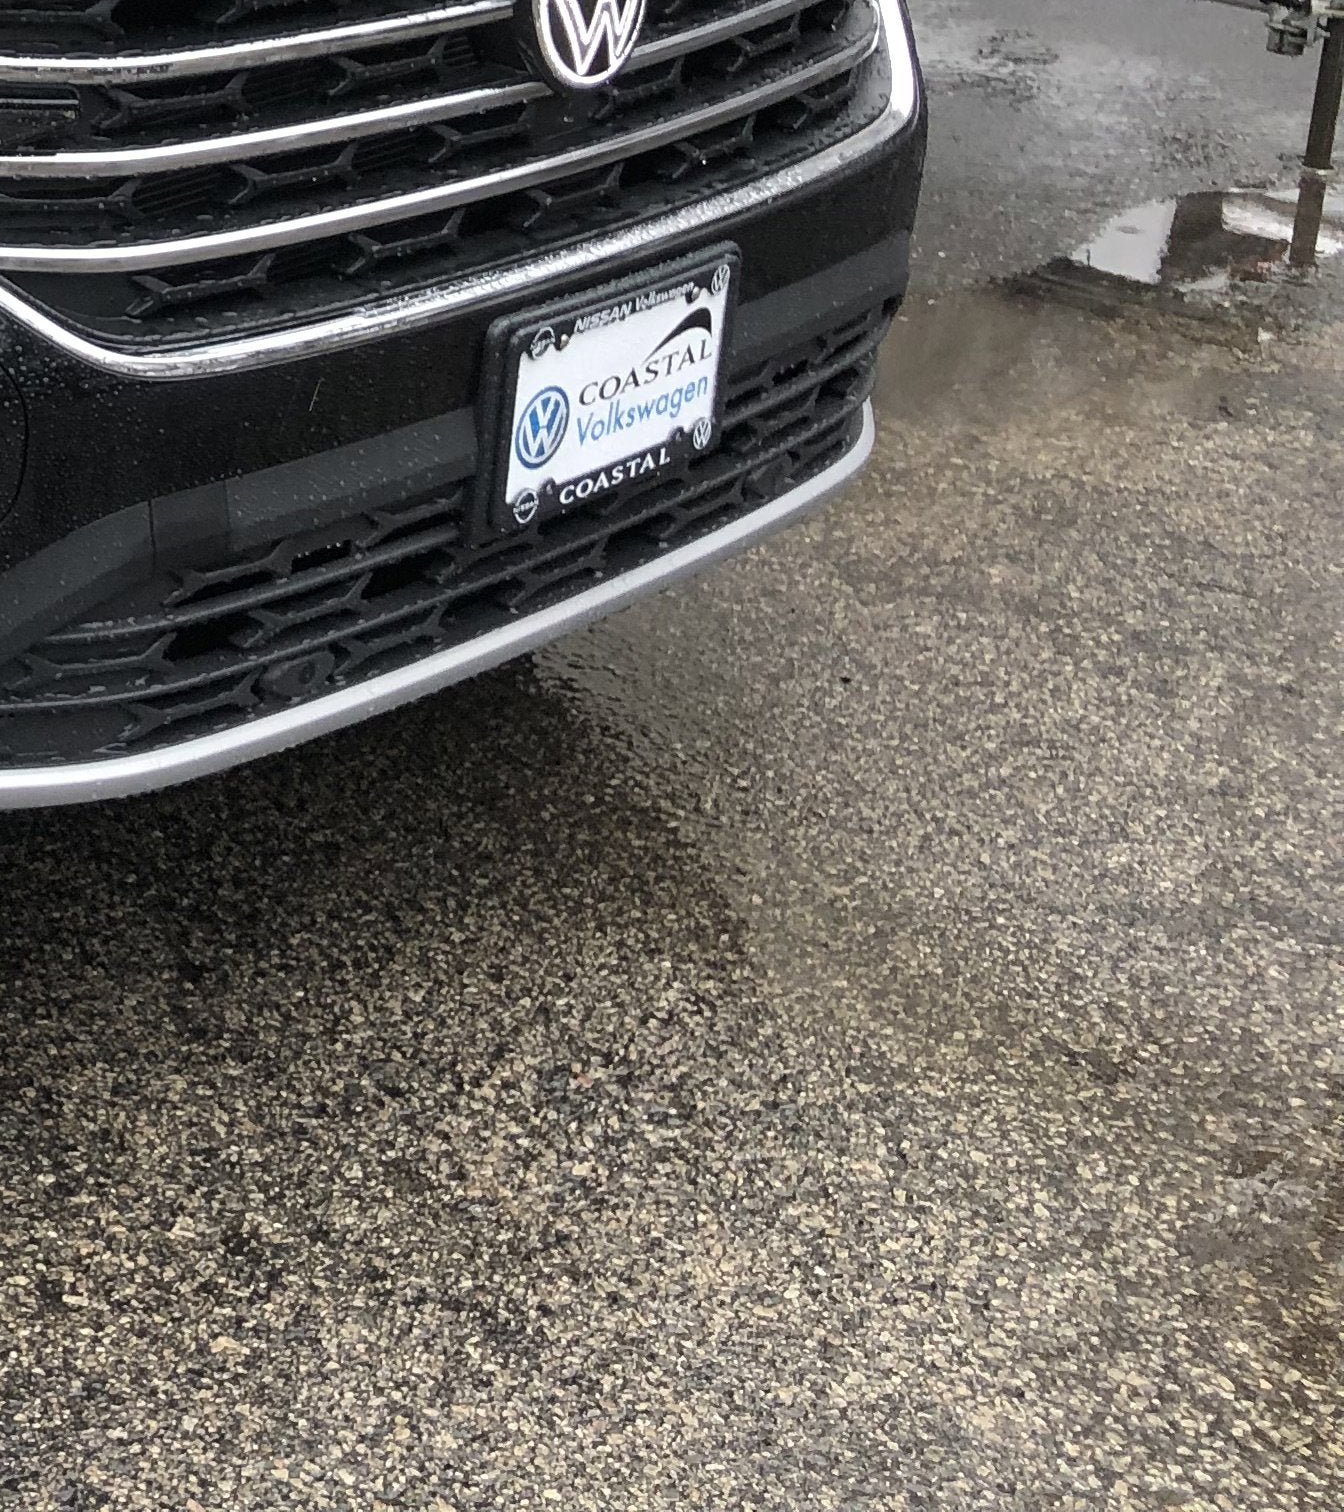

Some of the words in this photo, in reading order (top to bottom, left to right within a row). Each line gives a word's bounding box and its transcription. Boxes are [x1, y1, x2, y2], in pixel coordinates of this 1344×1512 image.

[574, 302, 632, 333] NISSAN
[579, 339, 713, 406] COASTAL
[518, 389, 568, 467] VW
[576, 376, 708, 446] Volkswagen
[559, 448, 670, 504] COASTAL
